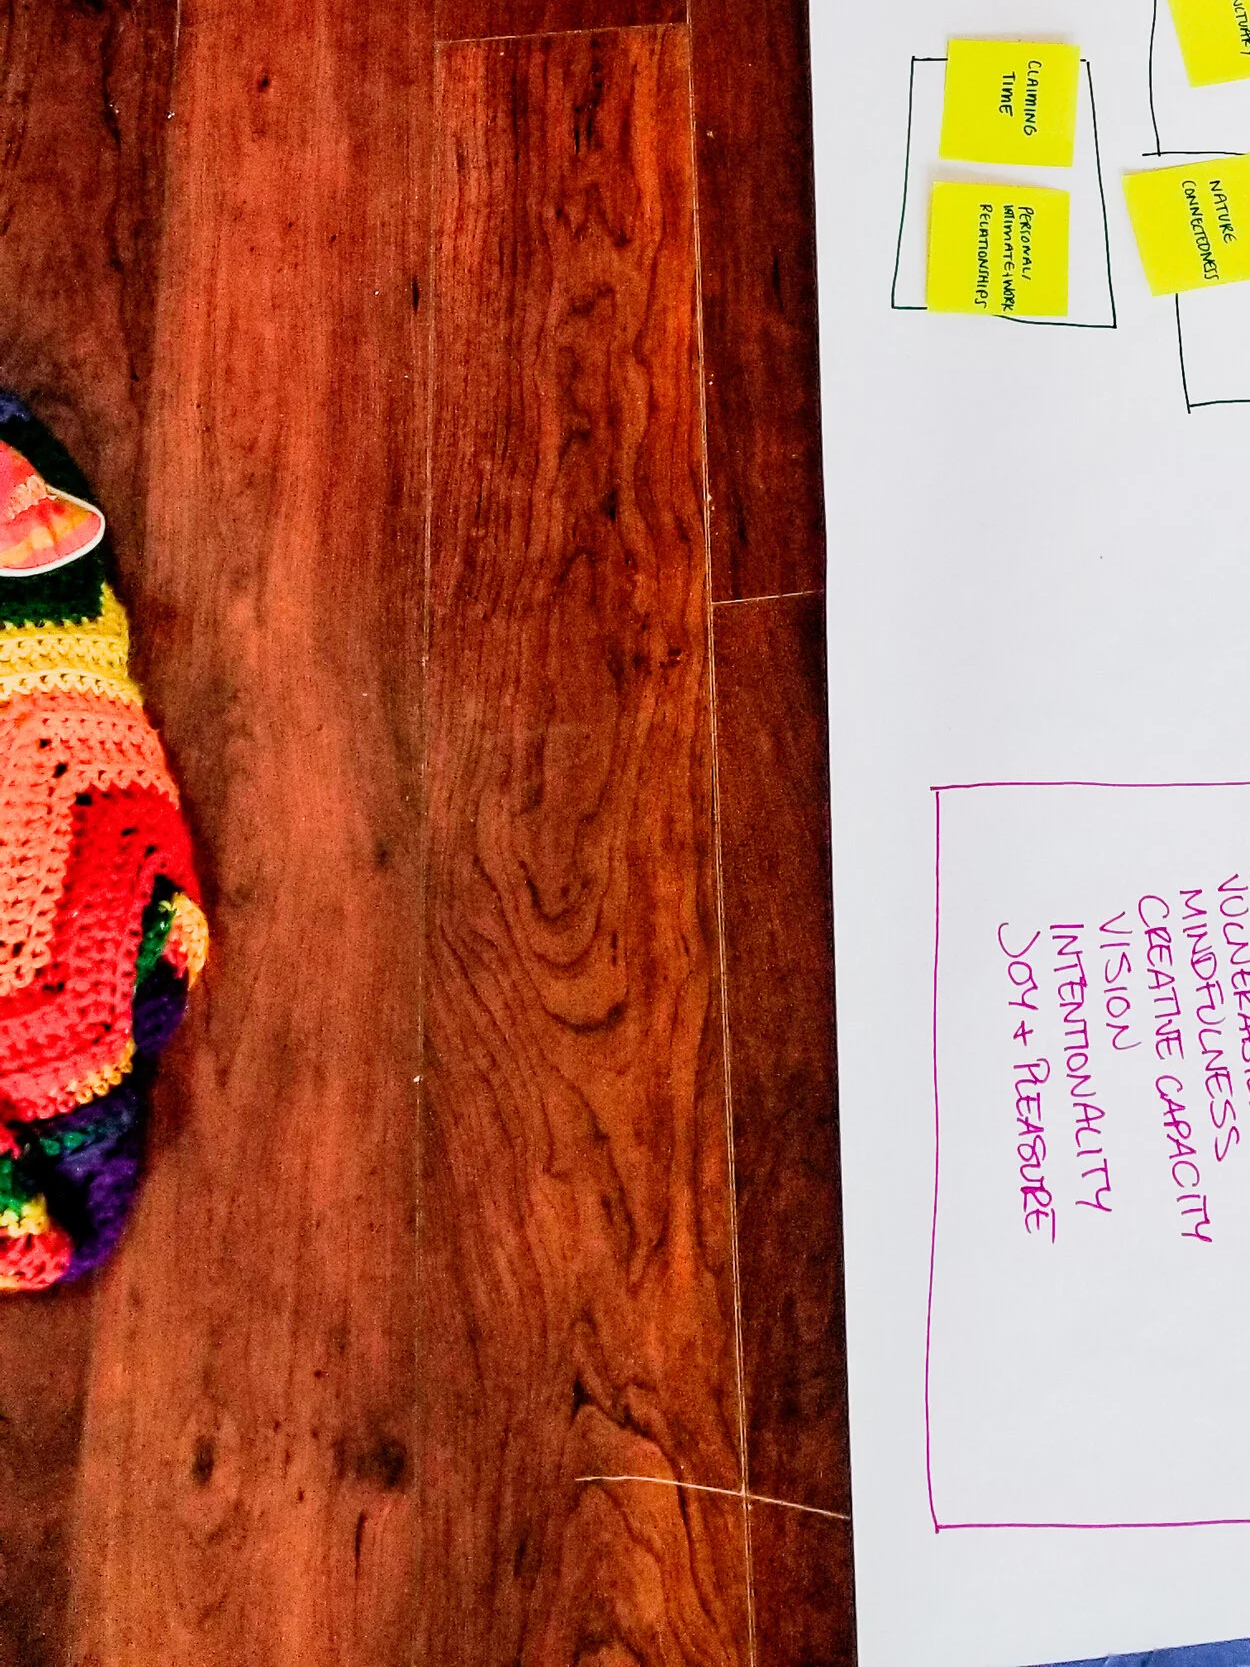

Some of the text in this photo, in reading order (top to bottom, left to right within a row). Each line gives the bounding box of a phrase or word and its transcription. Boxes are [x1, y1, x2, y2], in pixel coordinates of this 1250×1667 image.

[998, 71, 1015, 117] TIME
[1022, 59, 1041, 137] CLAIMING
[973, 204, 992, 309] RELATIONSHIPS
[1180, 180, 1219, 282] CONNECTEDNESS
[1208, 179, 1236, 245] NATURE
[997, 921, 1042, 1011] JOY
[1098, 912, 1141, 1051] VISION
[1048, 922, 1111, 1213] INTENTIONALITY
[1138, 894, 1212, 1243] CREATIVE CAPACITY
[1179, 888, 1239, 1163] MINDFULNESS
[1010, 1058, 1055, 1244] PLEASURE
